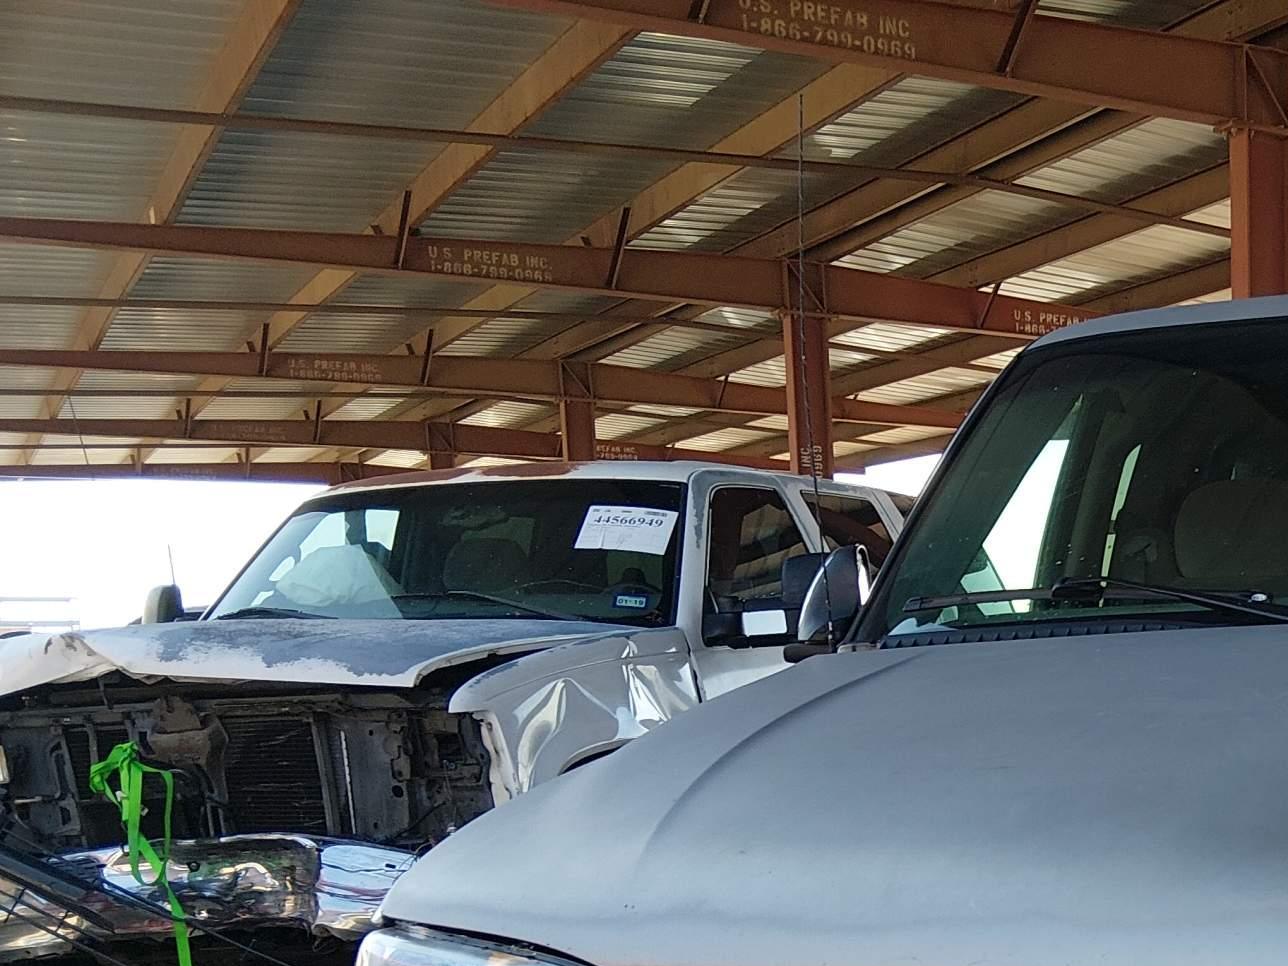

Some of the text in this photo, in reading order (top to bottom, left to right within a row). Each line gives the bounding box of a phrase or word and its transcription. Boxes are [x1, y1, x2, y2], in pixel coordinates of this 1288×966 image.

[790, 0, 869, 29] PREFAB
[879, 15, 911, 38] INC
[740, 13, 918, 60] 1-866-799-0969
[463, 248, 520, 267] PREFAB
[594, 514, 664, 527] 44566949
